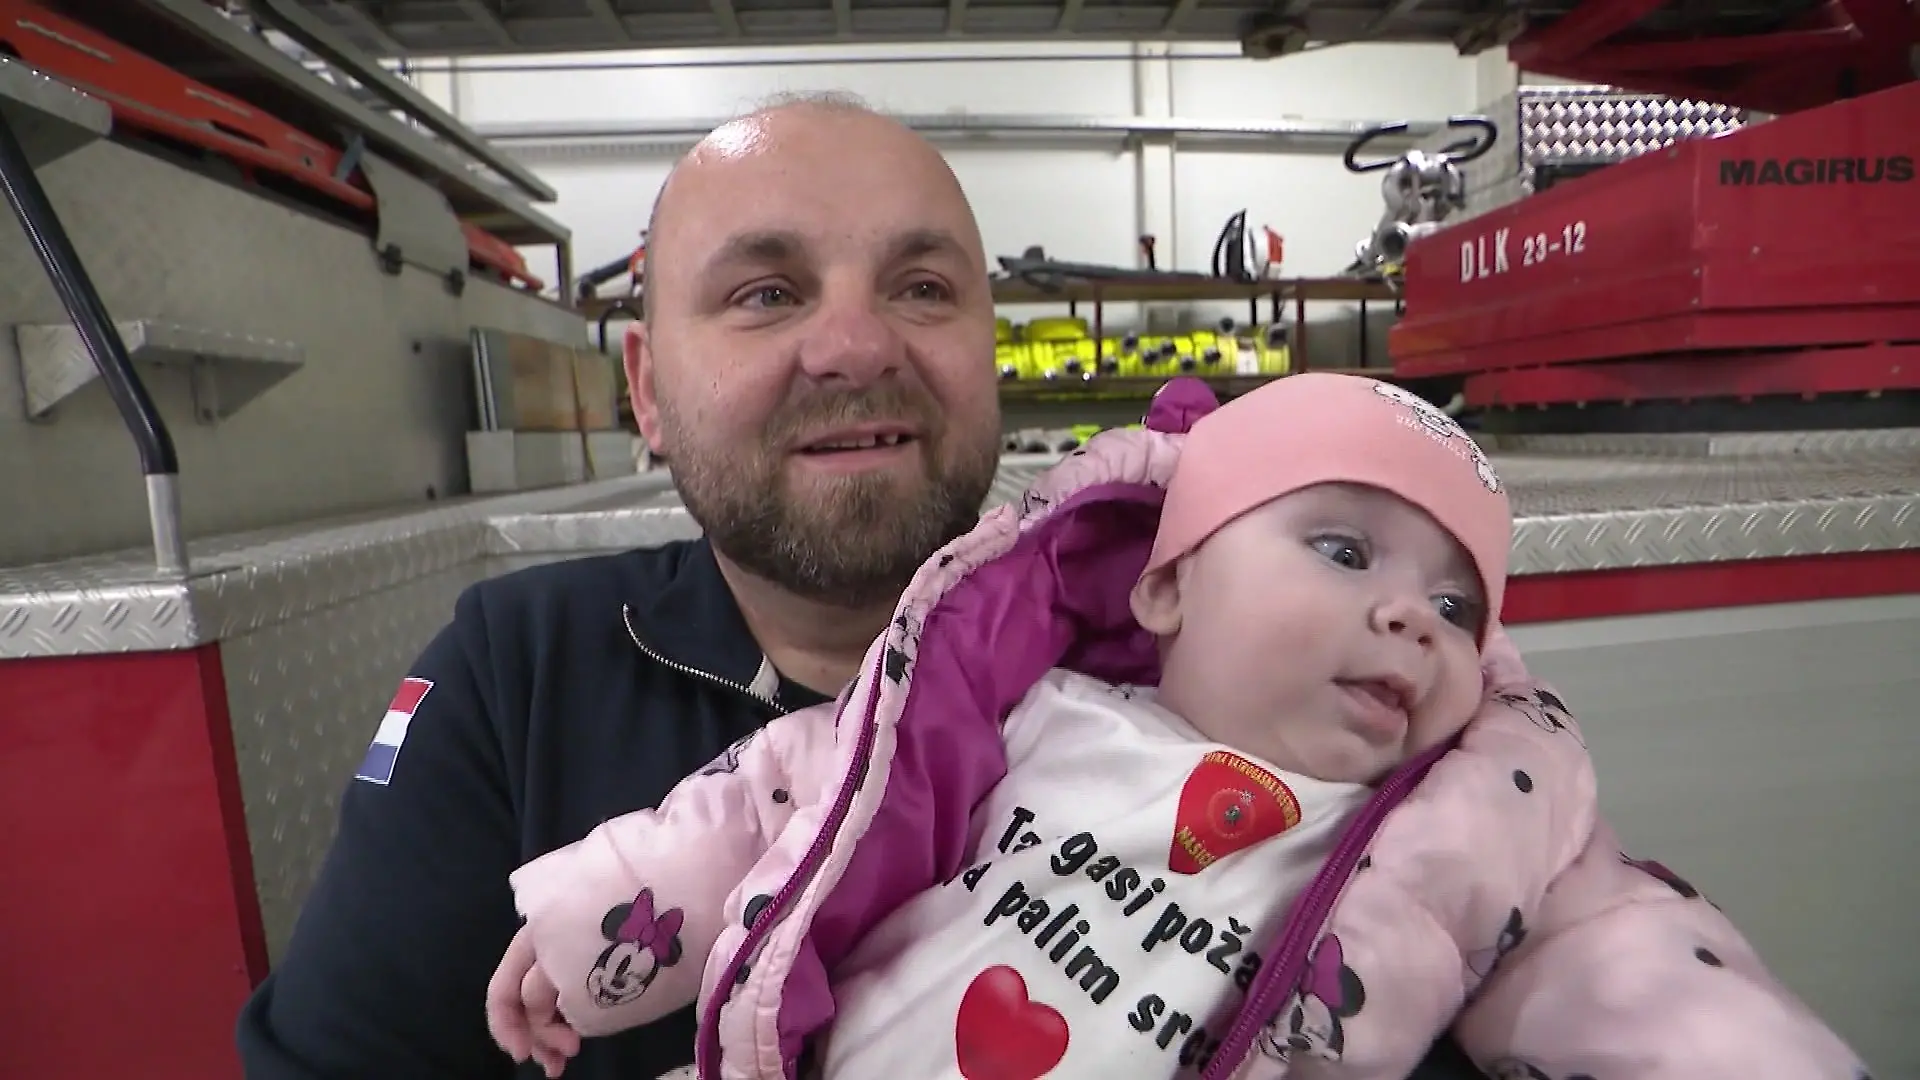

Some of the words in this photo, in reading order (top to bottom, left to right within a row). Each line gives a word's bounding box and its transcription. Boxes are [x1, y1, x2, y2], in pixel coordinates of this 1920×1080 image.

[1720, 156, 1915, 186] MAGIRUS
[1460, 227, 1511, 284] DLK
[1523, 220, 1586, 266] 23-12
[1050, 831, 1167, 916] gasi
[983, 880, 1120, 1005] palim
